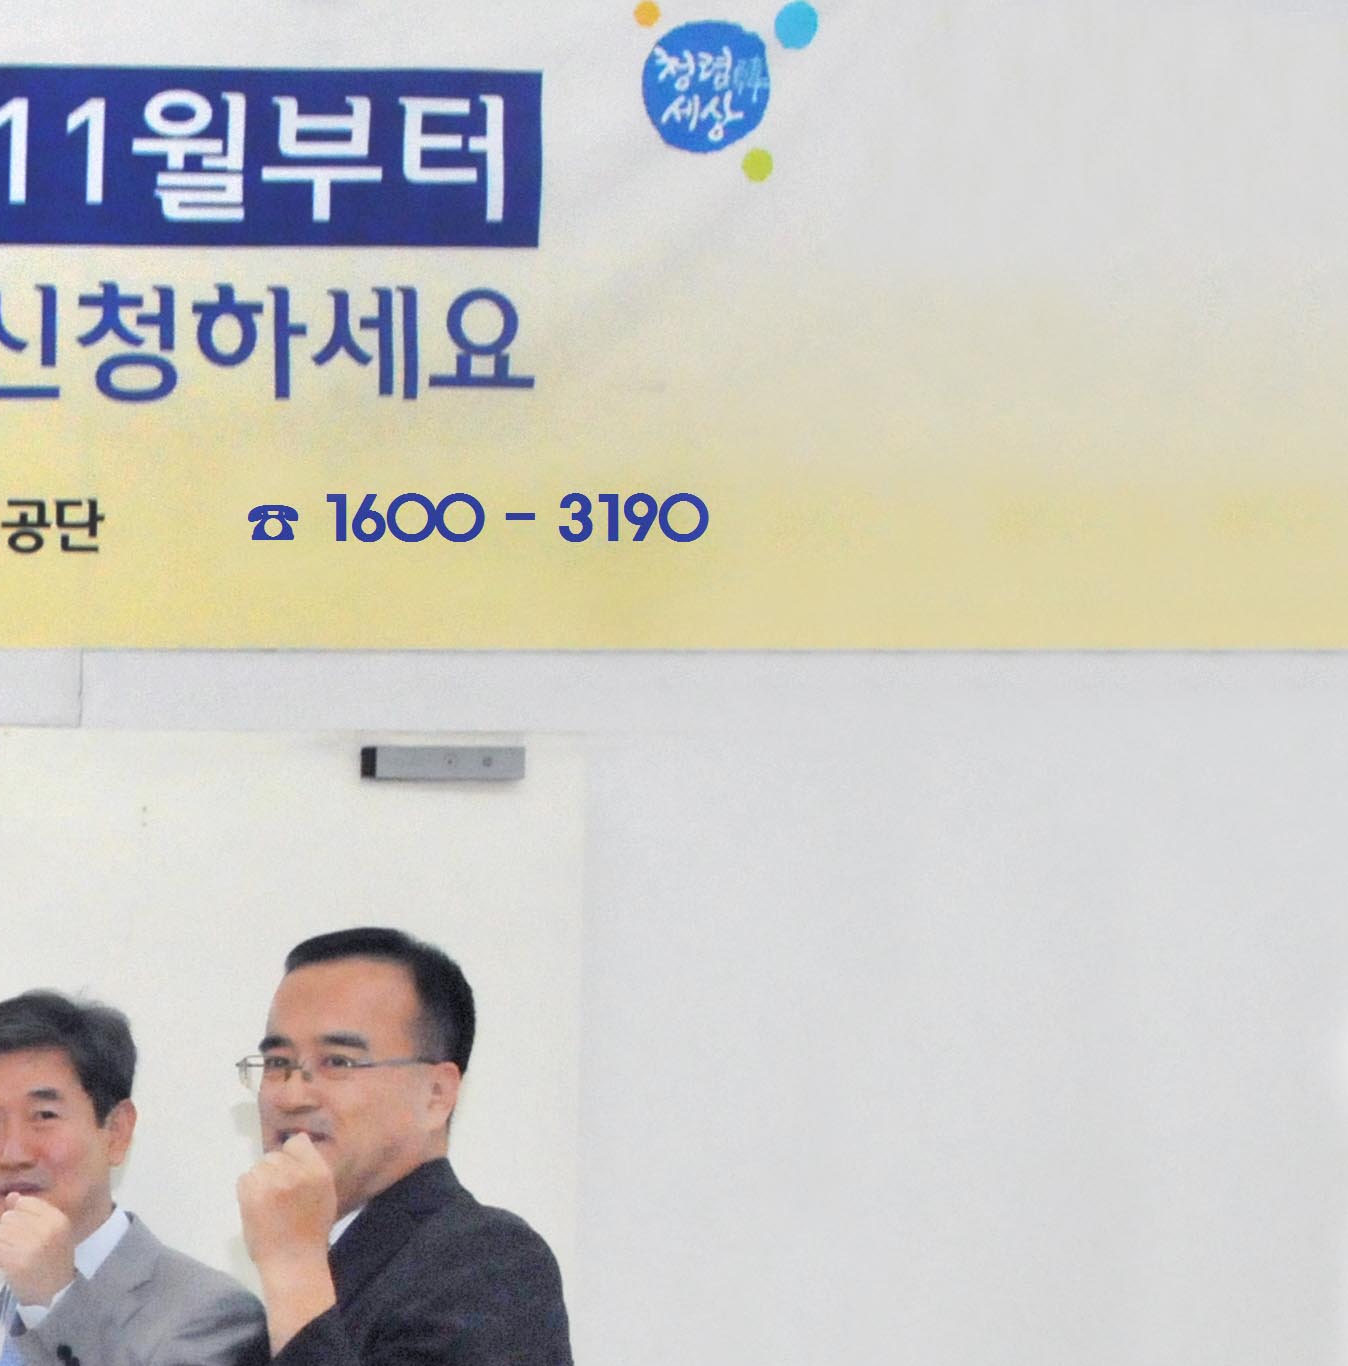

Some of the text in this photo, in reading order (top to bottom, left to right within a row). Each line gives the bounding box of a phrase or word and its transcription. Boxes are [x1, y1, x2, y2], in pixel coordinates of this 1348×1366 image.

[660, 89, 745, 142] 세상
[326, 492, 486, 543] 1600
[558, 492, 710, 543] 3190
